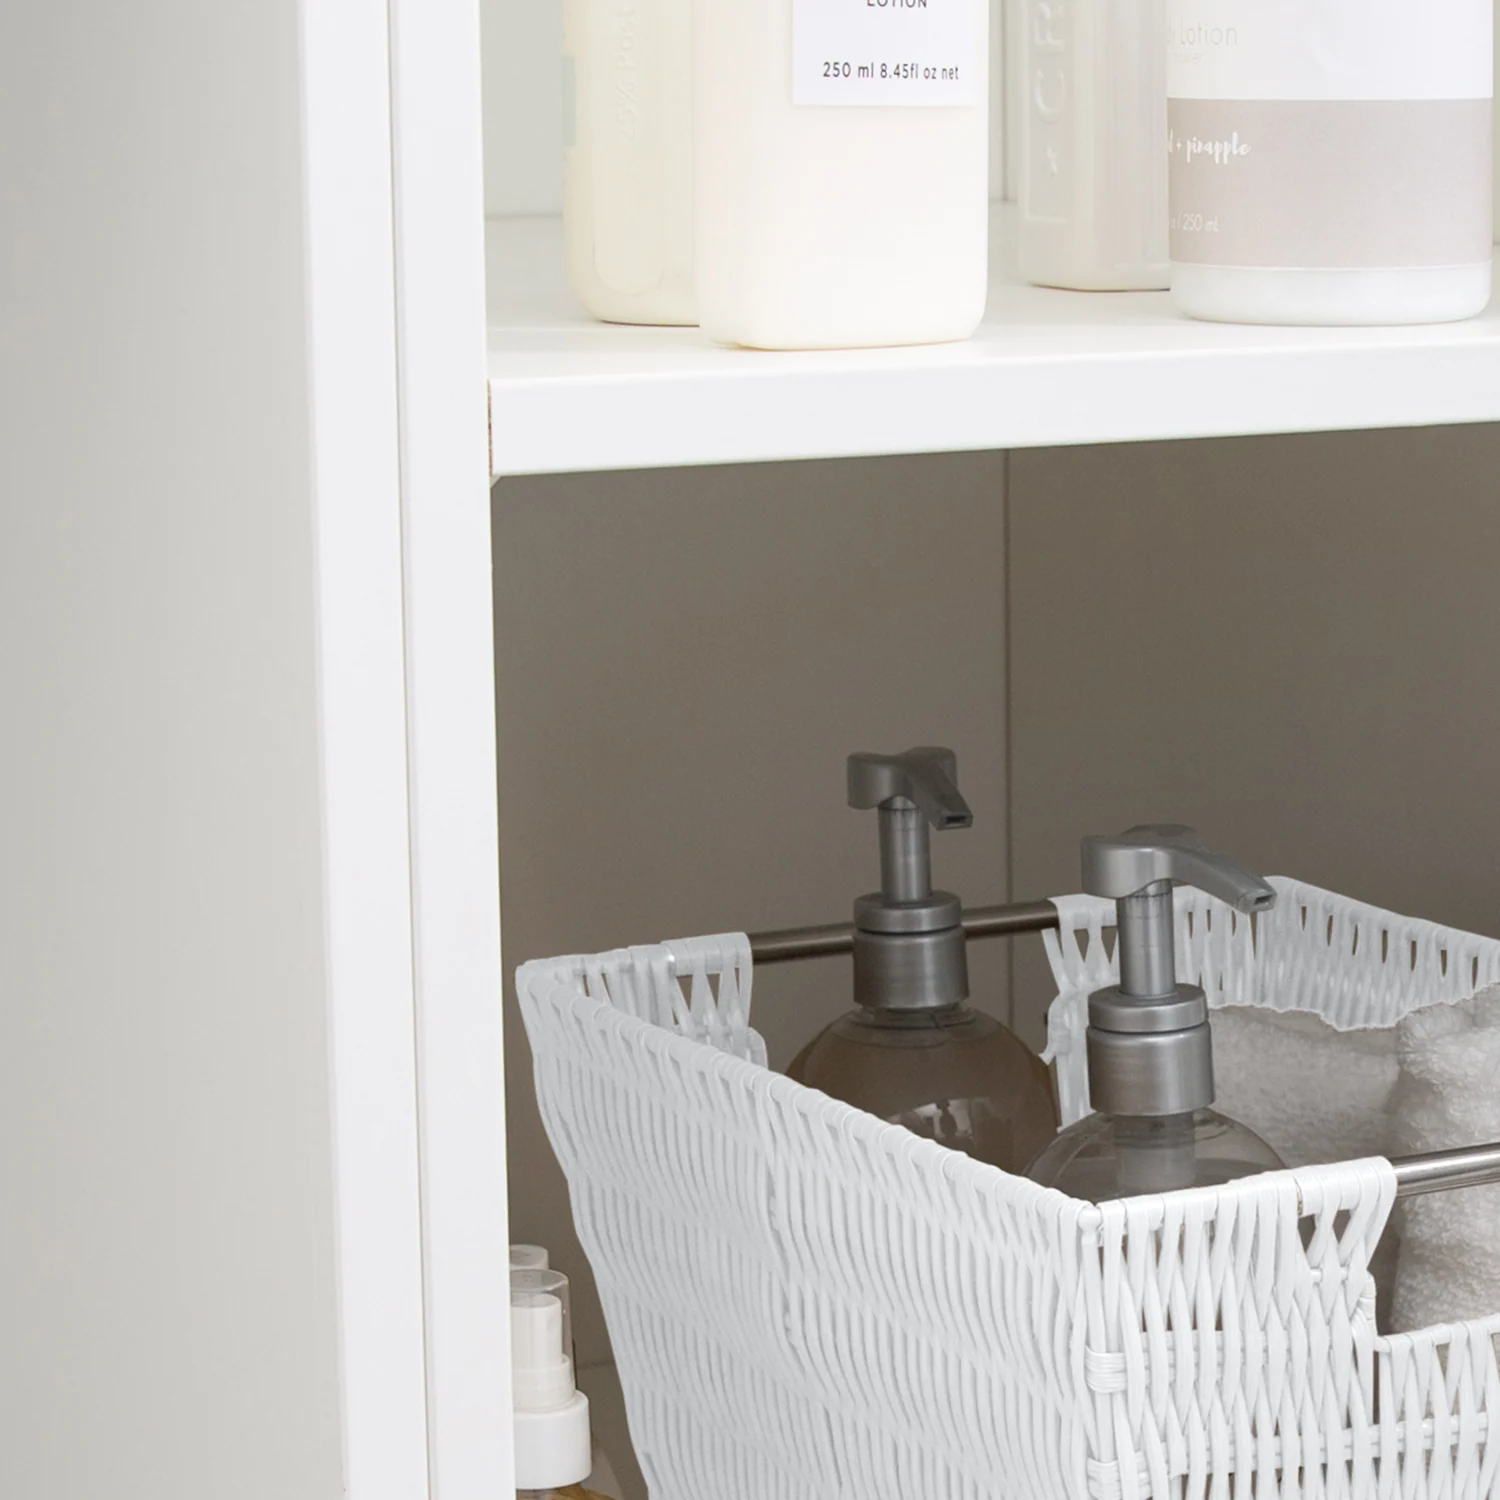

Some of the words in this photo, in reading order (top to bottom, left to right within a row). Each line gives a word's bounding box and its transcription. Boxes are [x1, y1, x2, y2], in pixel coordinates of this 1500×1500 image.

[822, 61, 851, 78] 250
[857, 62, 874, 78] ml
[879, 63, 919, 79] 8.45fl
[923, 66, 937, 80] oz
[941, 66, 959, 80] net
